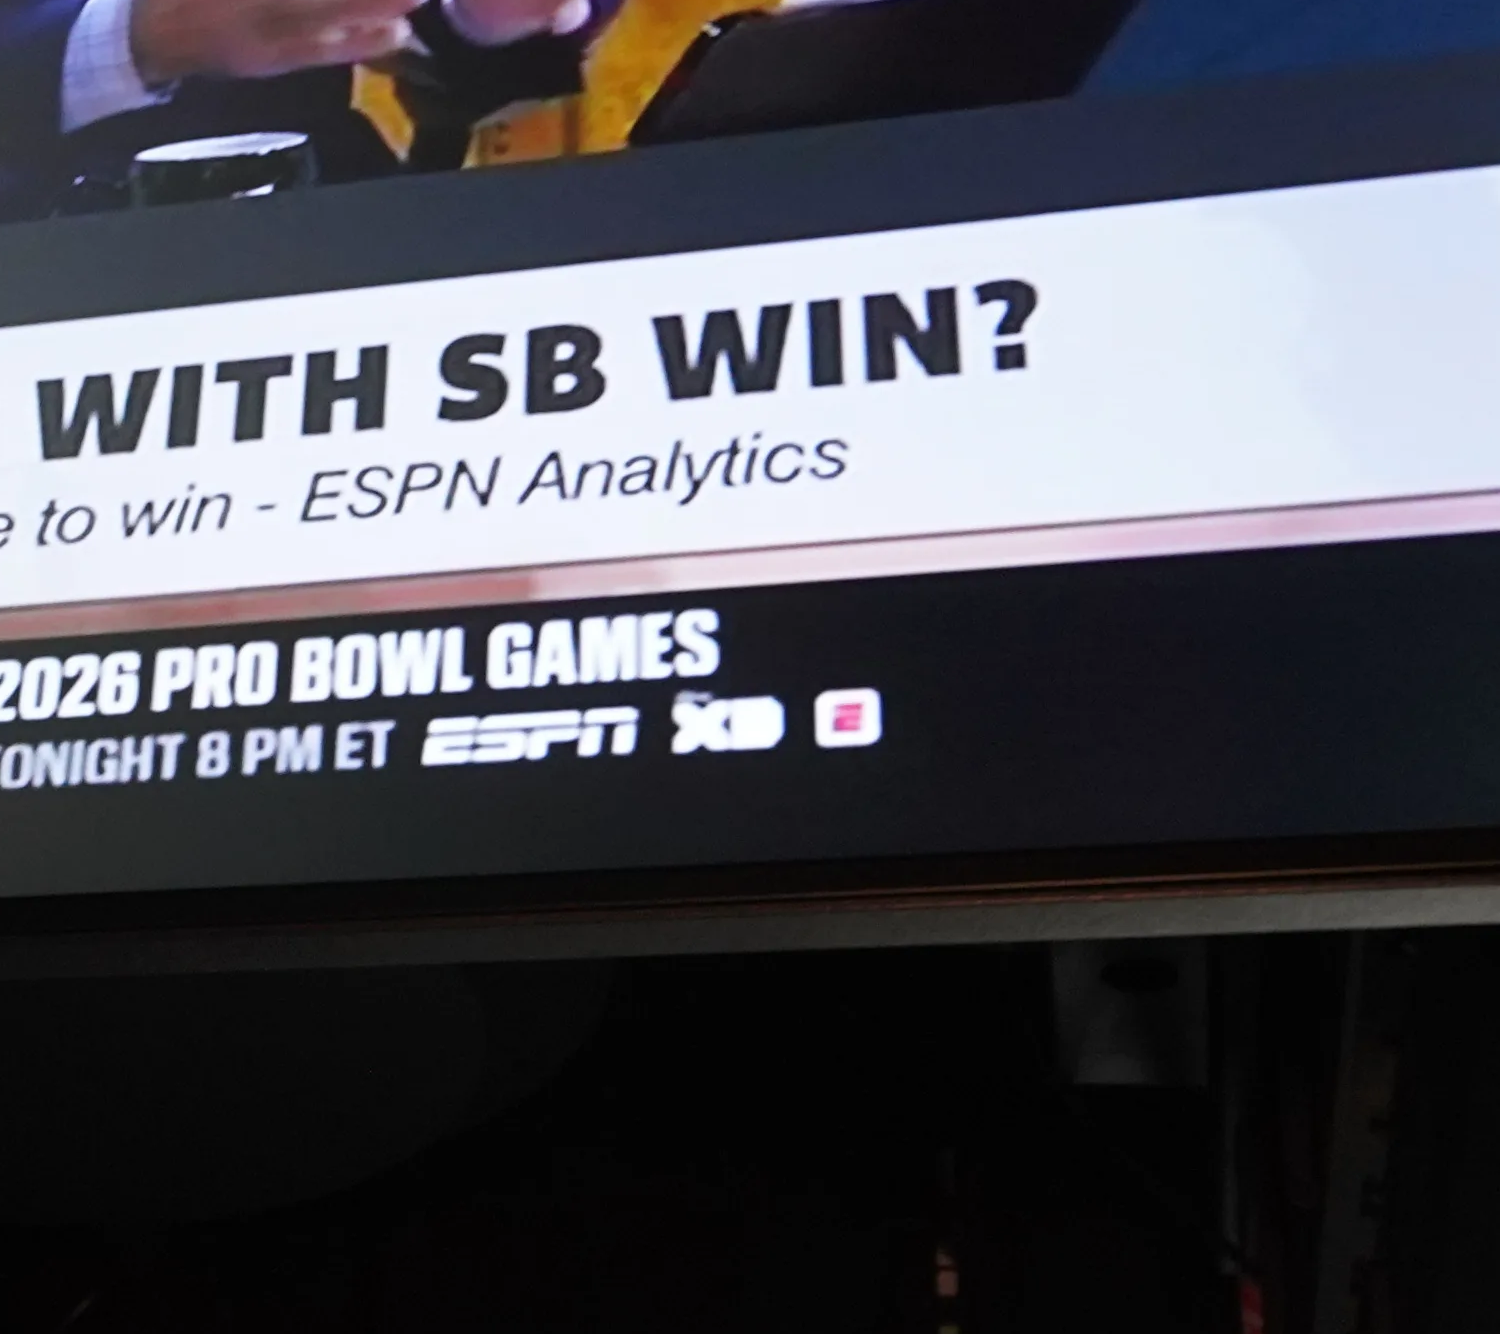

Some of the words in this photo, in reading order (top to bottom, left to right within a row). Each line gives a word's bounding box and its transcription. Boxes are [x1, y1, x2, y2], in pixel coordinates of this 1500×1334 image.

[37, 344, 389, 460] WITH
[438, 324, 606, 422] SB
[652, 279, 1037, 401] WIN?
[37, 500, 96, 546] to
[123, 484, 231, 537] win
[301, 457, 501, 522] ESPN
[518, 433, 847, 506] Analytics
[151, 641, 278, 712] PRO
[290, 627, 473, 702] BOWL
[486, 609, 719, 689] GAMES
[196, 731, 229, 777] 8
[242, 725, 322, 775] PM
[335, 720, 396, 769] ET
[421, 706, 640, 766] ESPN
